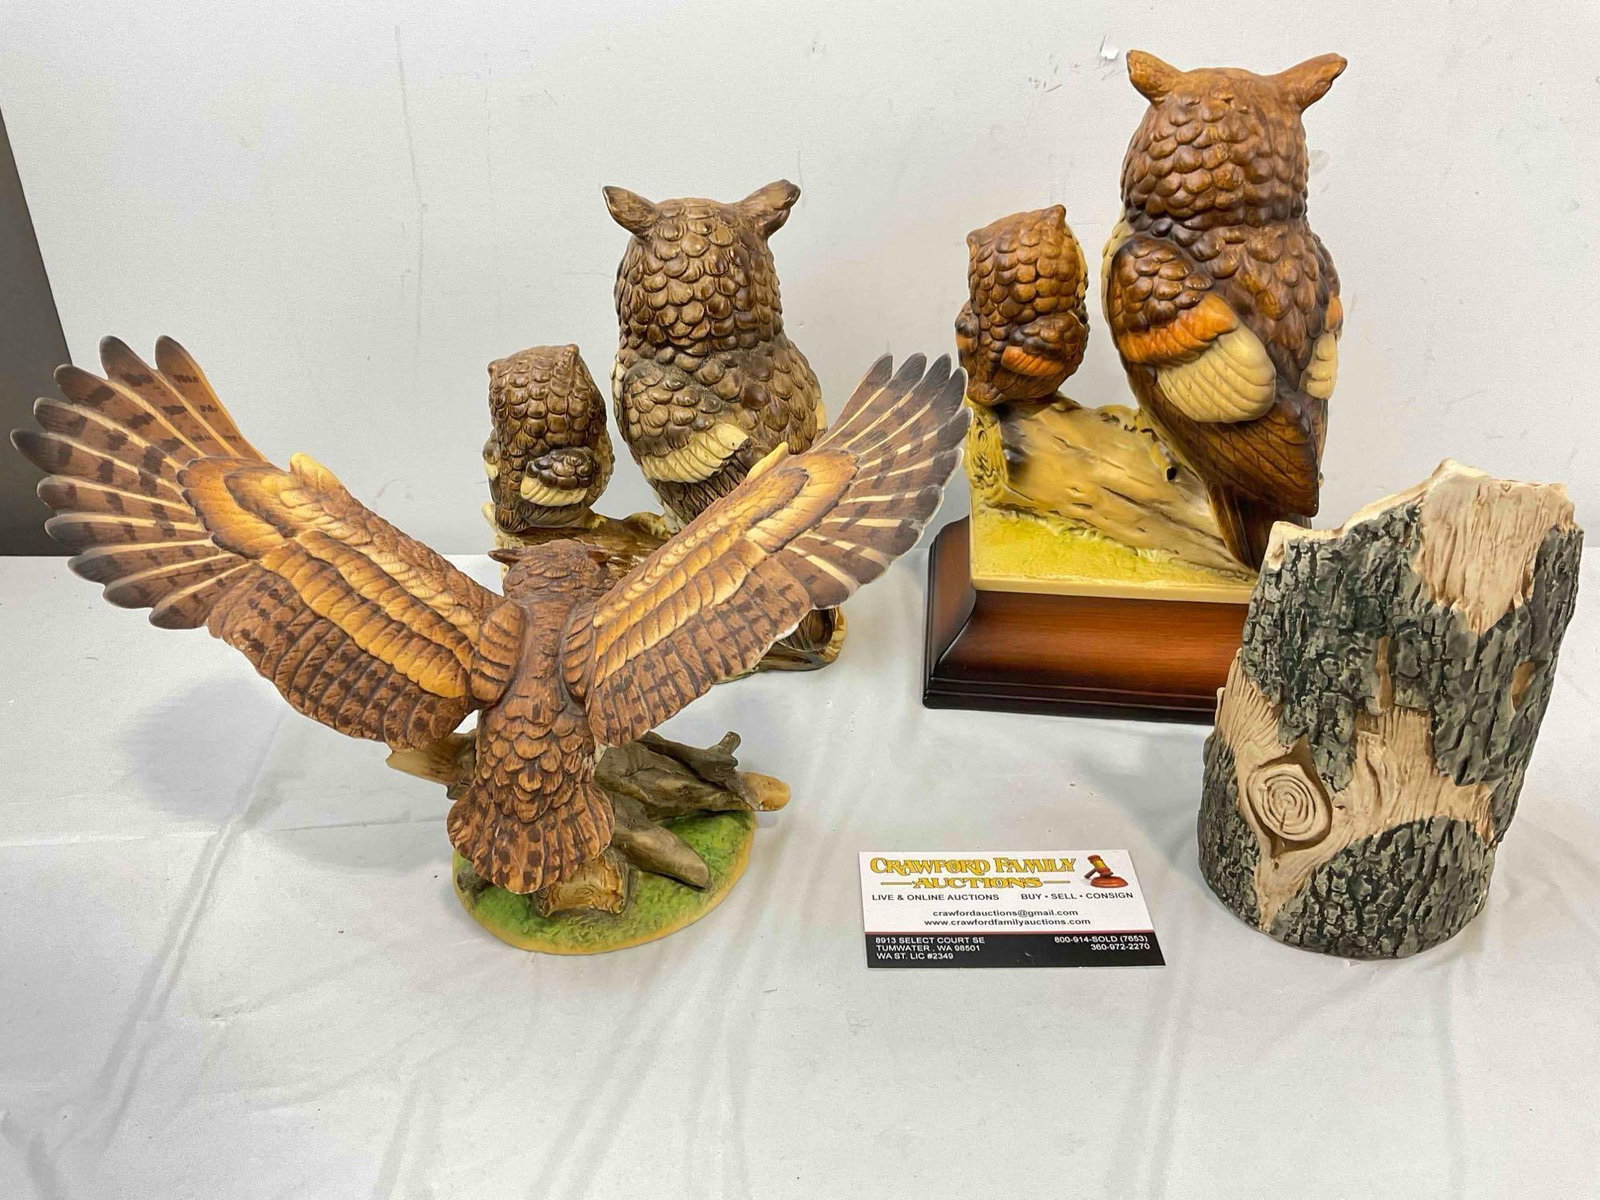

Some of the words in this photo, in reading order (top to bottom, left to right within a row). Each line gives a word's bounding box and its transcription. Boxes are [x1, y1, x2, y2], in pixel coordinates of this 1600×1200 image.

[870, 857, 991, 876] CRAWFORD
[993, 857, 1076, 874] FAMILY
[912, 877, 1043, 889] AUCTIONS
[1051, 892, 1077, 900] SELL
[933, 910, 1079, 918] crawfordauctions@gmail.com
[924, 918, 1091, 927] www.crawfordfamilyauctions.com
